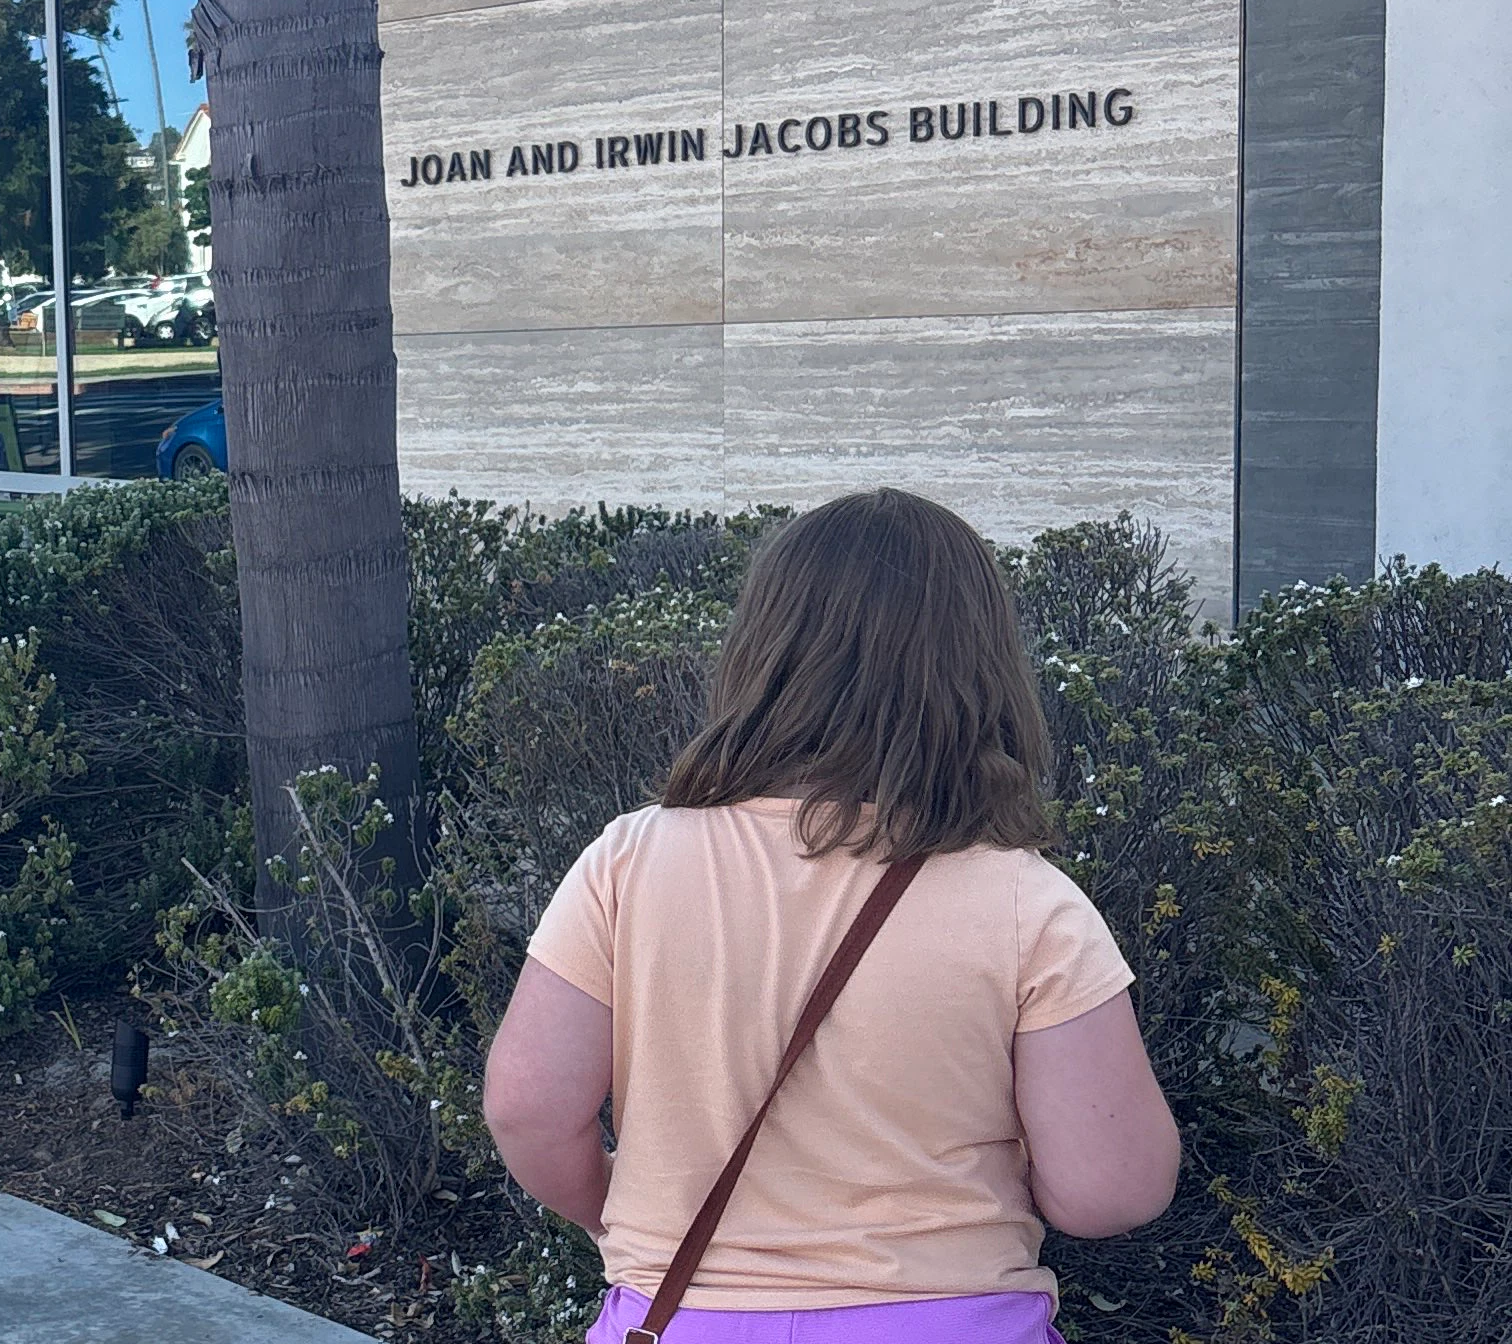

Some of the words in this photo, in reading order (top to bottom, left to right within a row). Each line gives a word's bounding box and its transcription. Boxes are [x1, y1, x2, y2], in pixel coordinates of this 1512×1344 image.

[400, 149, 492, 187] JOAN
[506, 140, 579, 177] AND
[595, 128, 705, 169] IRWIN
[722, 110, 889, 158] JACOBS
[909, 88, 1134, 143] BUILDING
